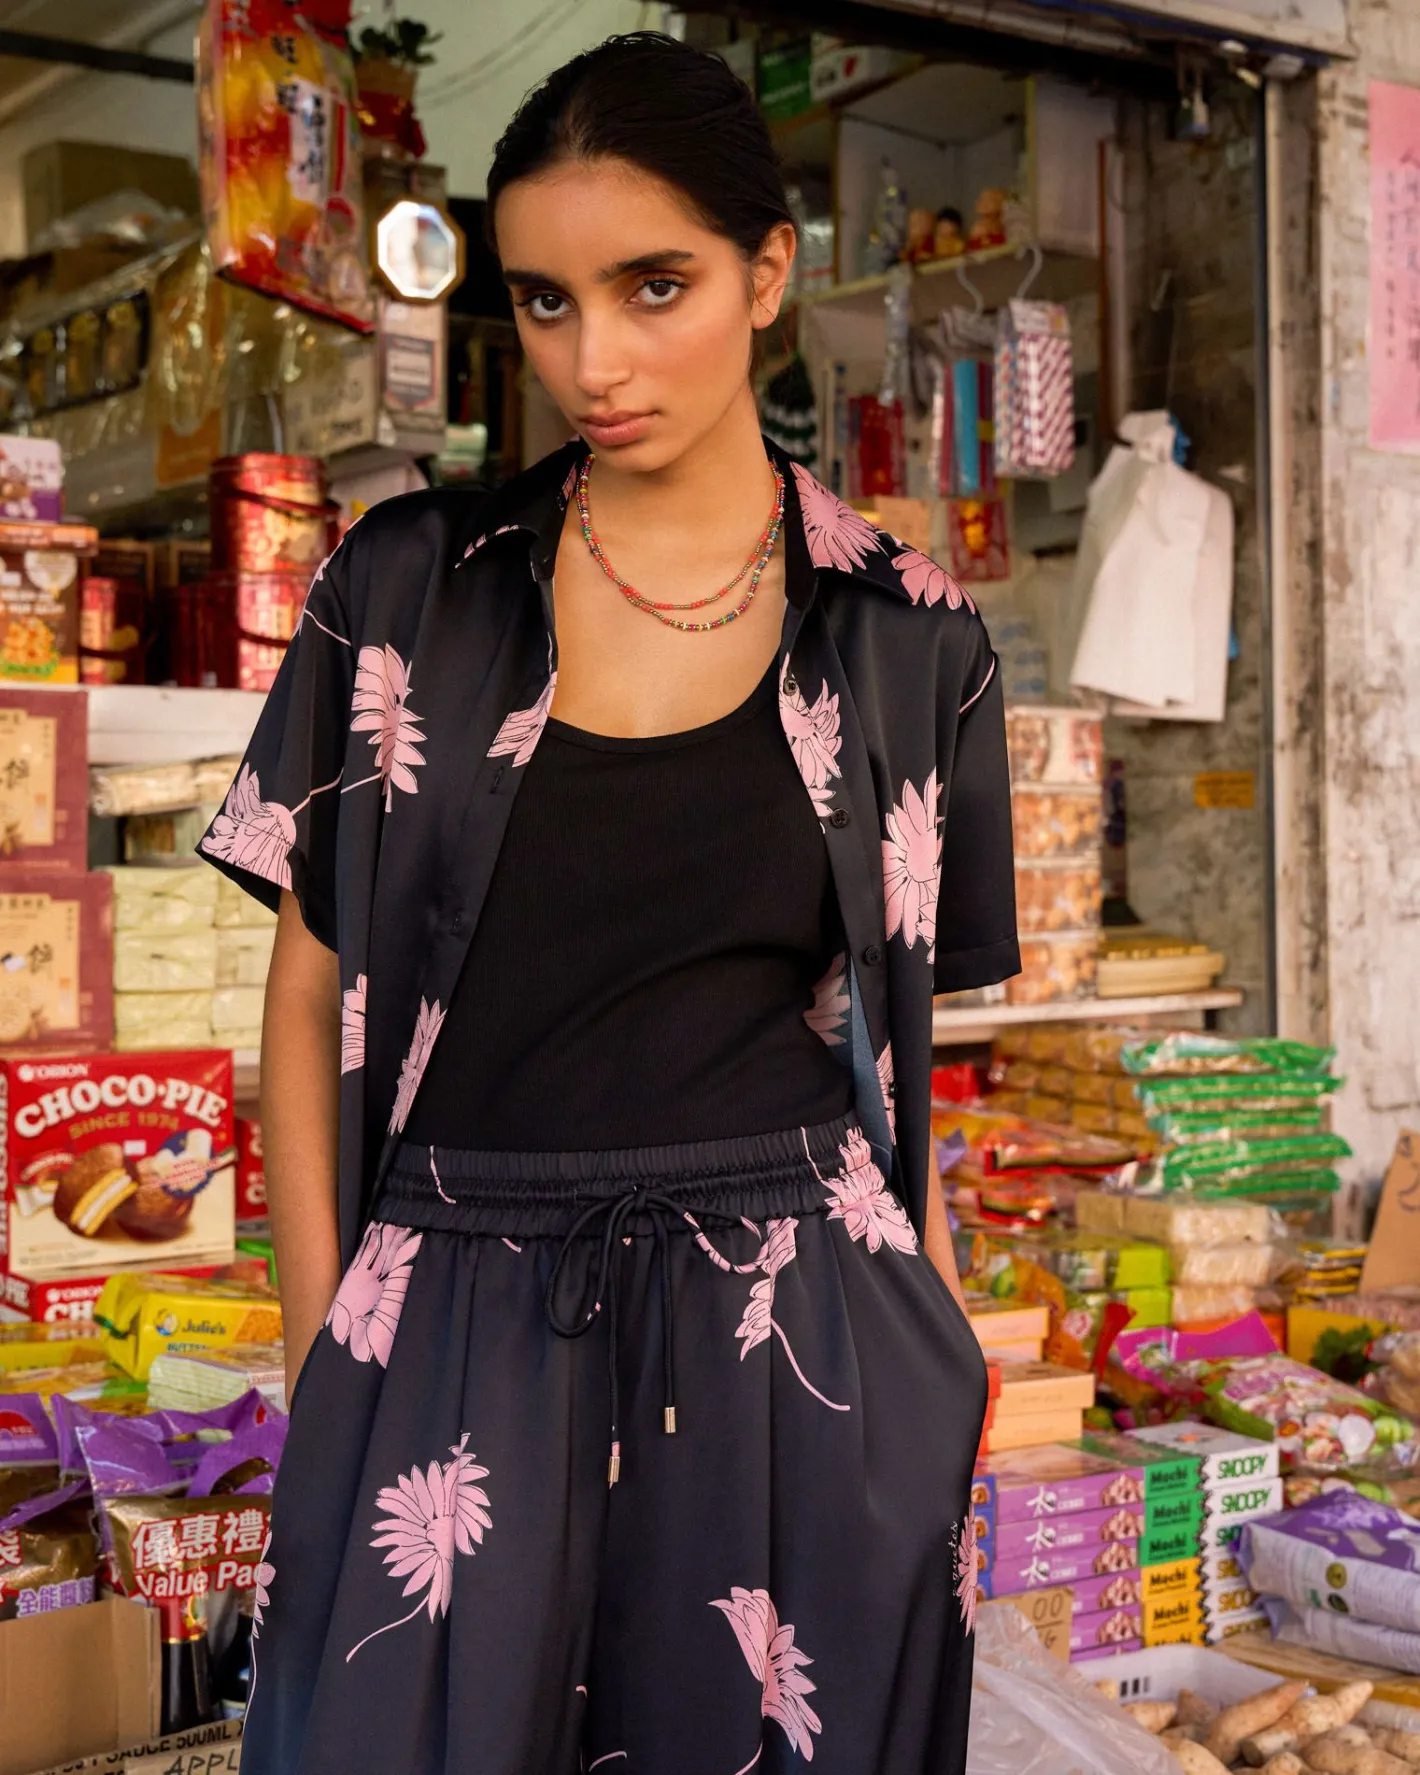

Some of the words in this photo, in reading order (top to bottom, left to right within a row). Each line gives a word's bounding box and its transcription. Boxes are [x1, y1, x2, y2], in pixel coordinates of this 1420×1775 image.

[68, 1112, 130, 1139] SINCE
[183, 1319, 226, 1335] Julie's
[1151, 1466, 1187, 1483] Mochi
[1154, 1499, 1191, 1518] Mochi
[132, 1508, 272, 1569] 優惠禮
[1150, 1533, 1187, 1552] Mochi
[135, 1568, 209, 1597] Value
[1151, 1567, 1187, 1585] Mochi
[1154, 1601, 1190, 1620] Mochi
